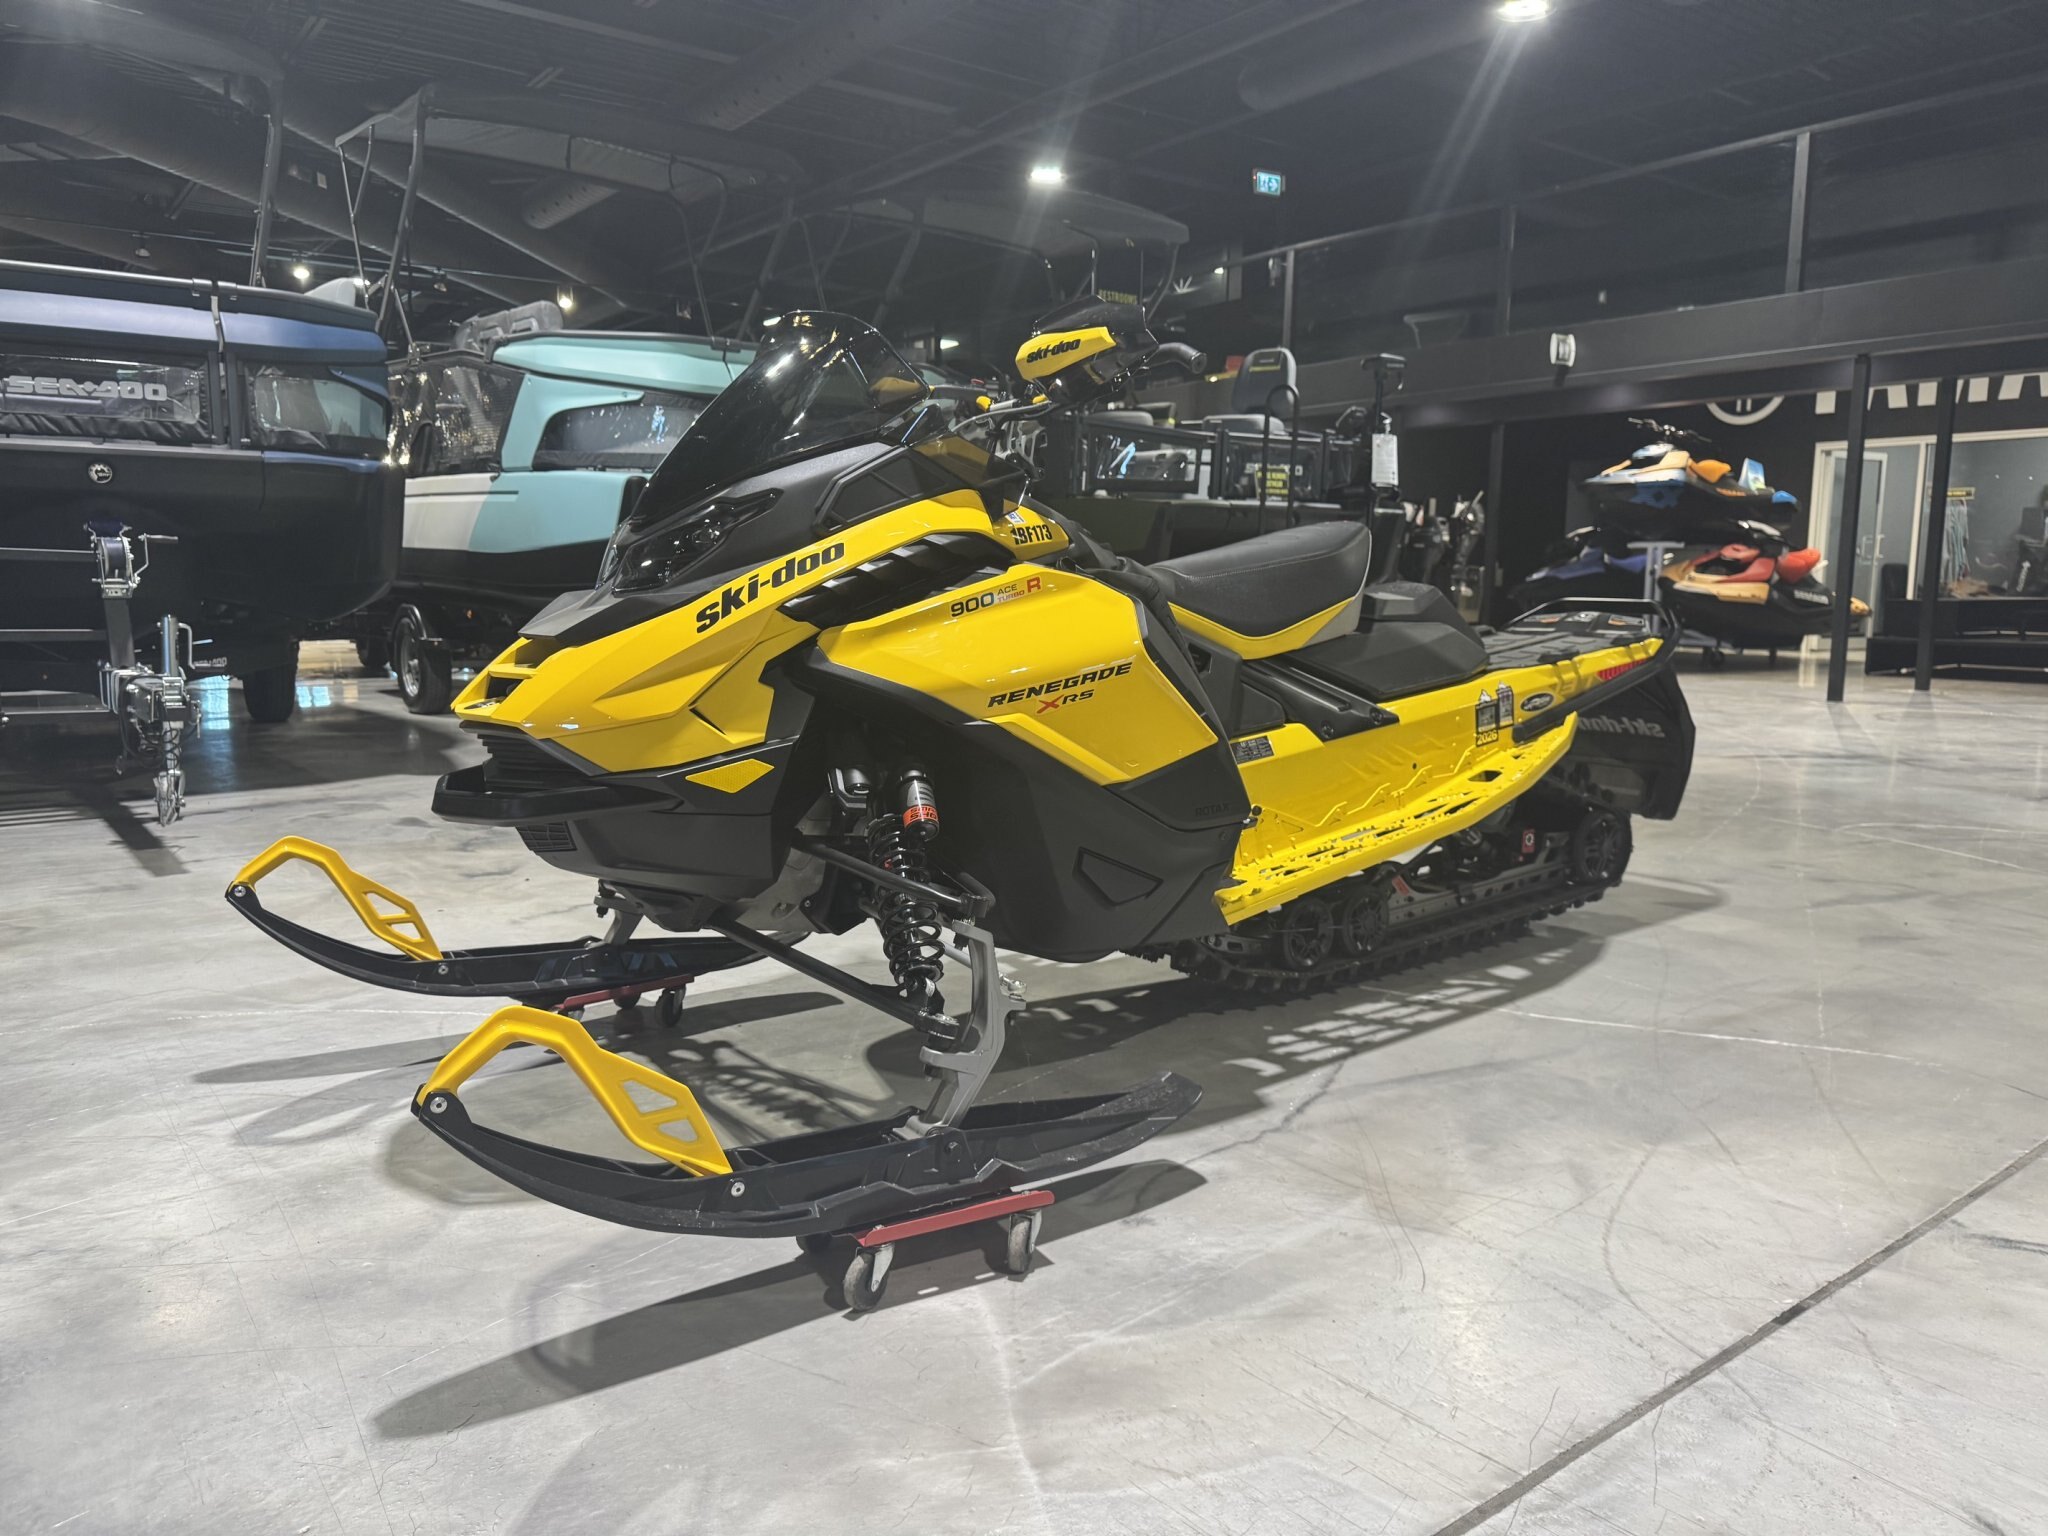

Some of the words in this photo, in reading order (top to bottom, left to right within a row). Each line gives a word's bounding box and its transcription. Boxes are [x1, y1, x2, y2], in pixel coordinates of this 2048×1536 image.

[1026, 338, 1081, 363] ski-doo
[696, 543, 845, 634] ski-doo
[951, 592, 995, 617] 900
[998, 583, 1018, 596] ACE
[998, 590, 1025, 603] TURBO
[1027, 576, 1042, 593] R
[988, 662, 1132, 708] RENEGADE
[1477, 730, 1498, 746] 2026
[1195, 803, 1230, 817] ROTAX
